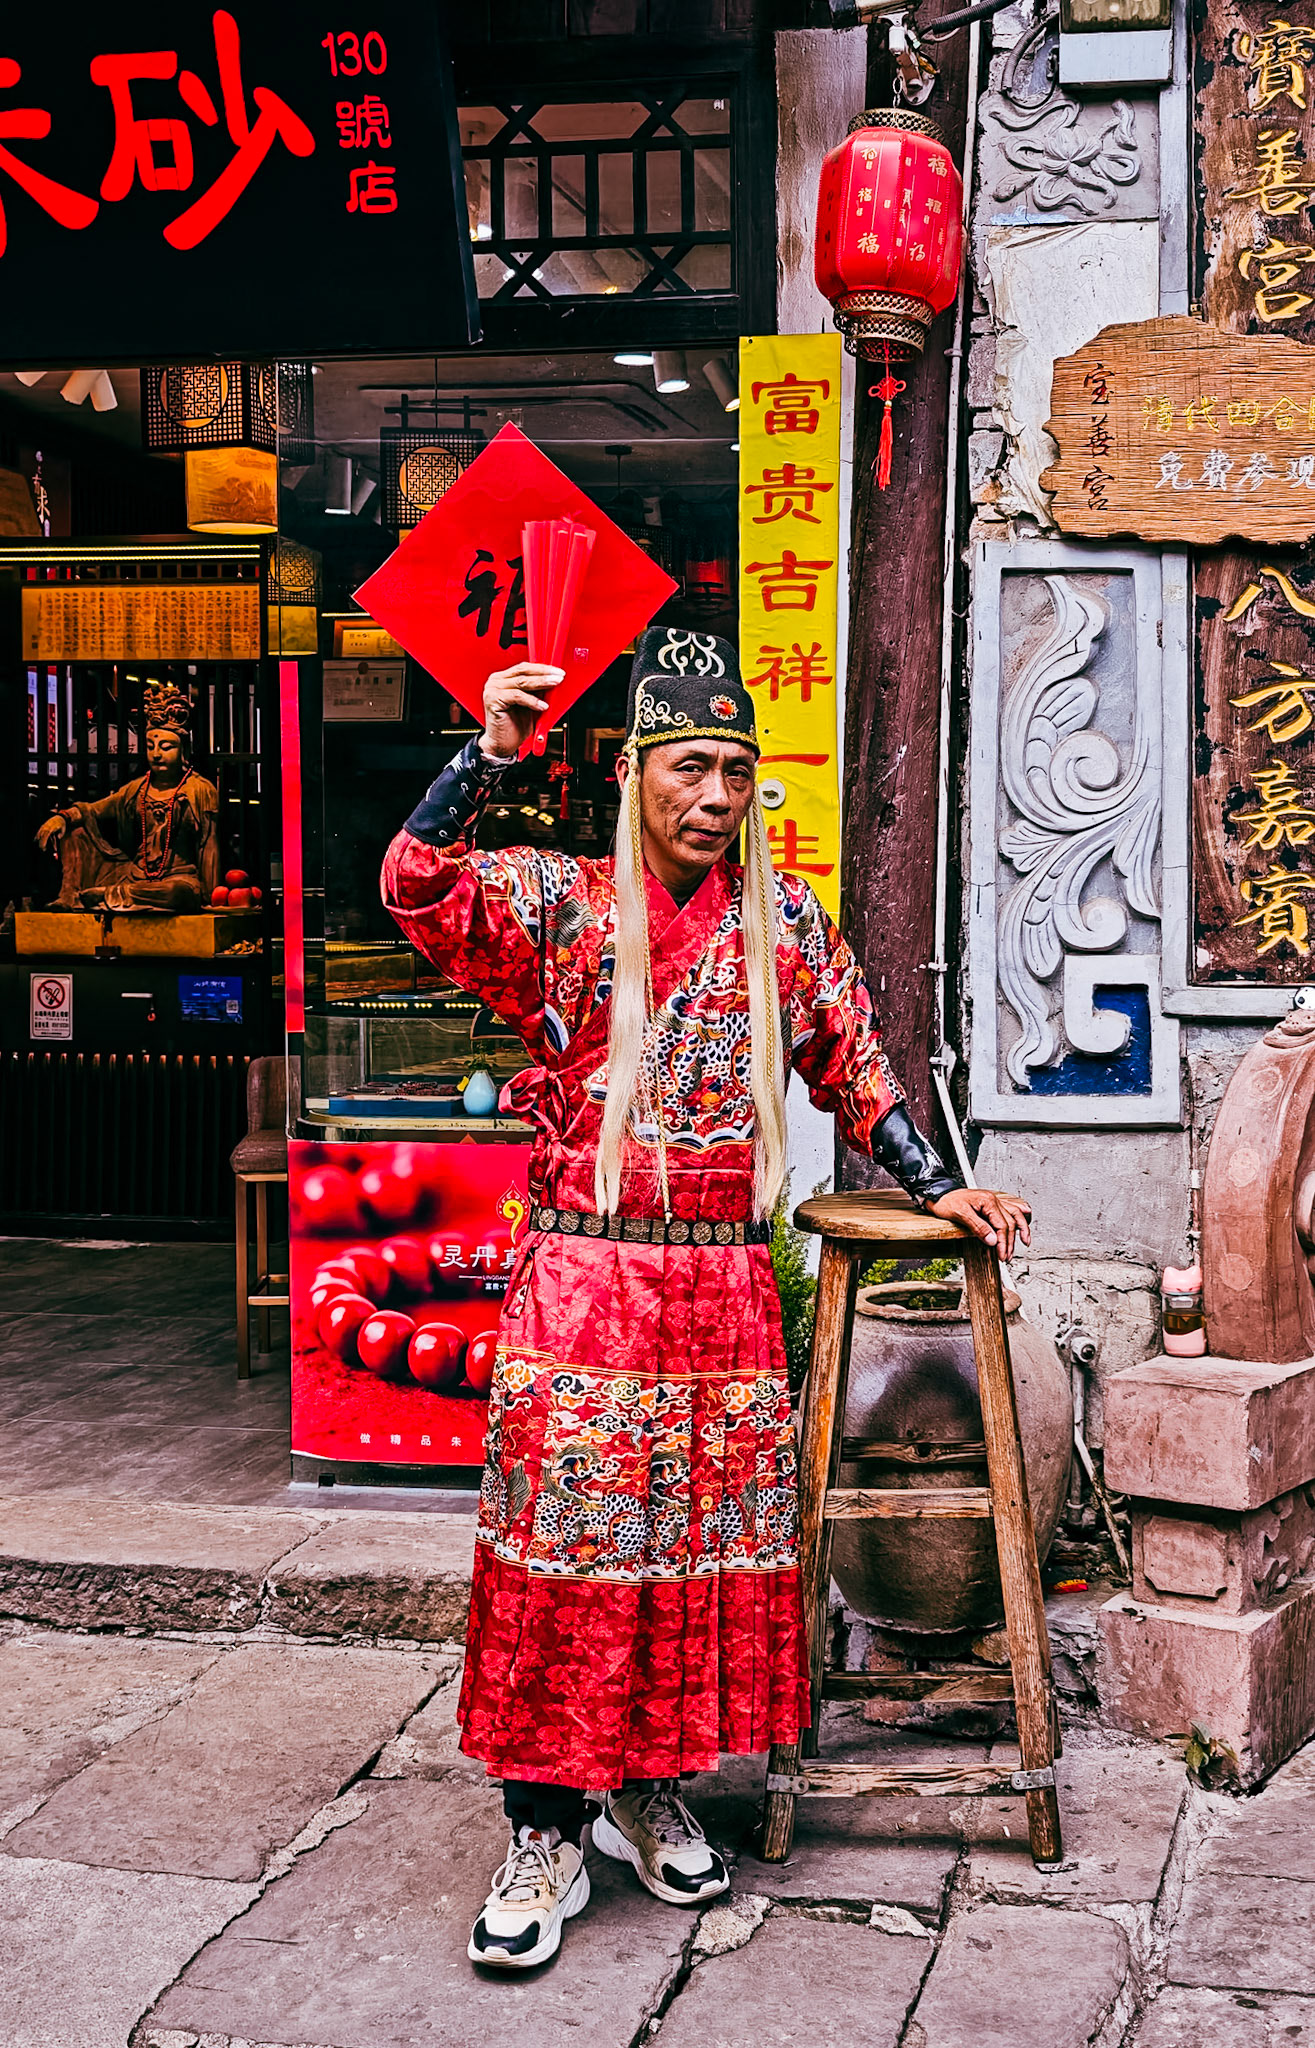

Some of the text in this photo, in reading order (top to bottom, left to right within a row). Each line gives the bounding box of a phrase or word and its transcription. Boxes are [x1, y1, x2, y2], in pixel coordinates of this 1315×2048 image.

[928, 154, 948, 178] 福
[858, 187, 873, 203] 福
[925, 197, 942, 214] 福
[857, 232, 880, 254] 福
